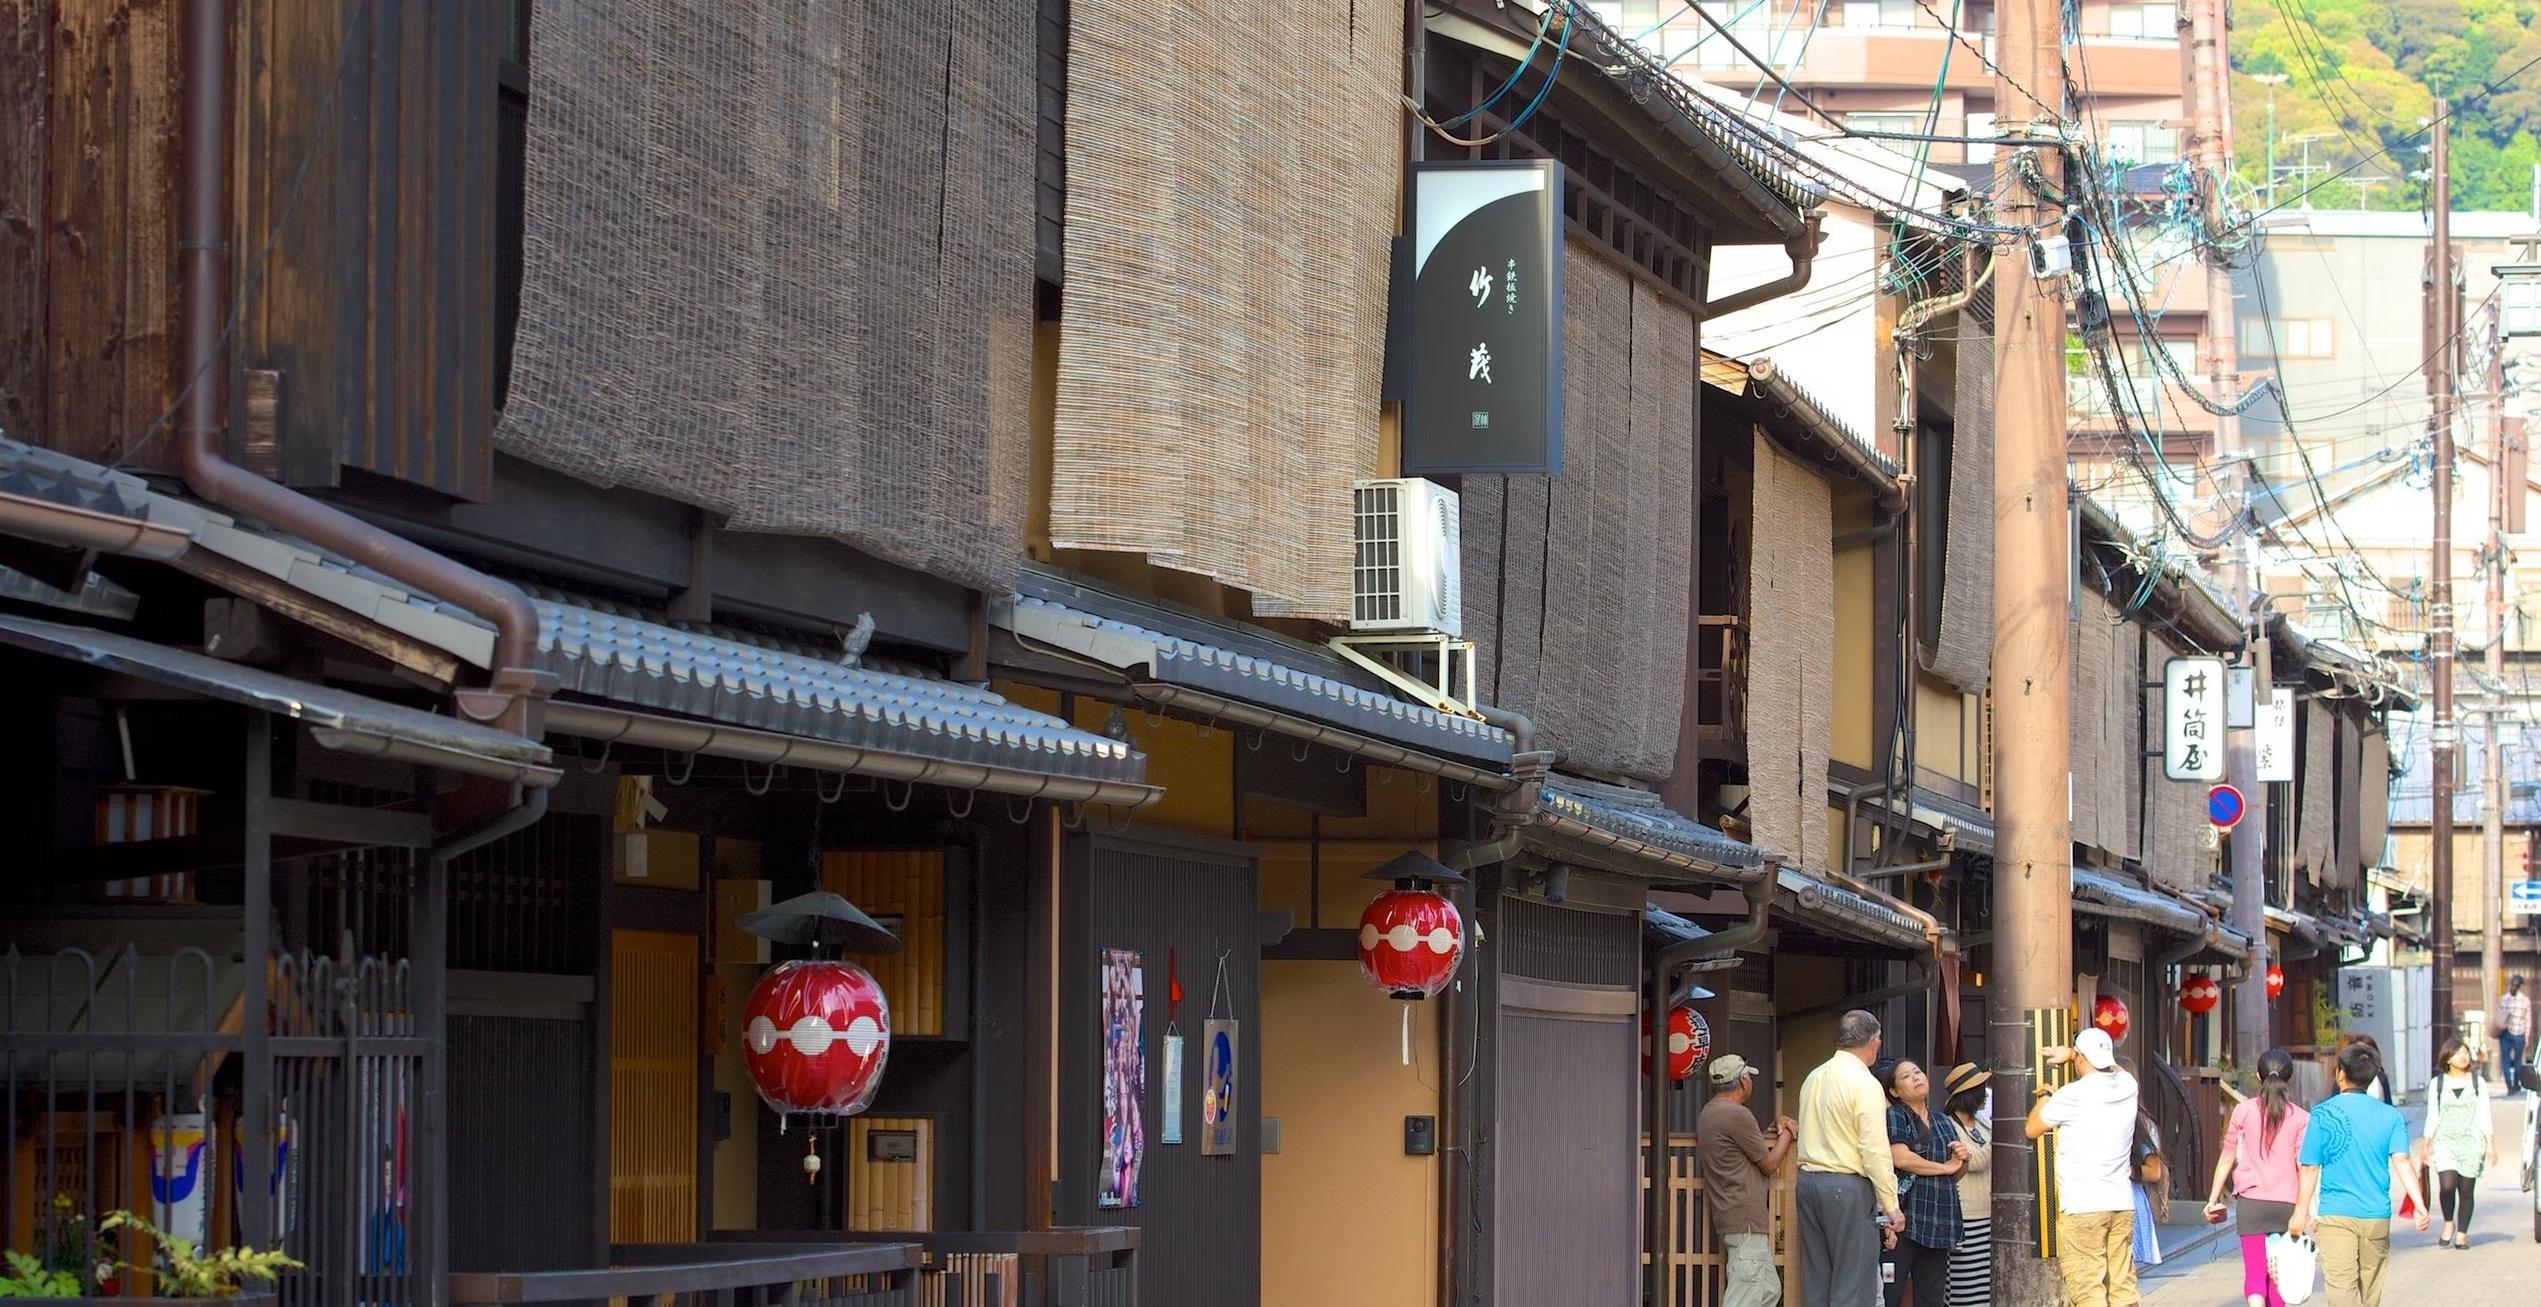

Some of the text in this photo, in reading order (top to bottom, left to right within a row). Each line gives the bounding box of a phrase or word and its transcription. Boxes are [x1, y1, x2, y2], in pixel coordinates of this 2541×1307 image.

[2177, 669, 2208, 772] 井筒屋
[2366, 974, 2375, 1018] KYOWA
